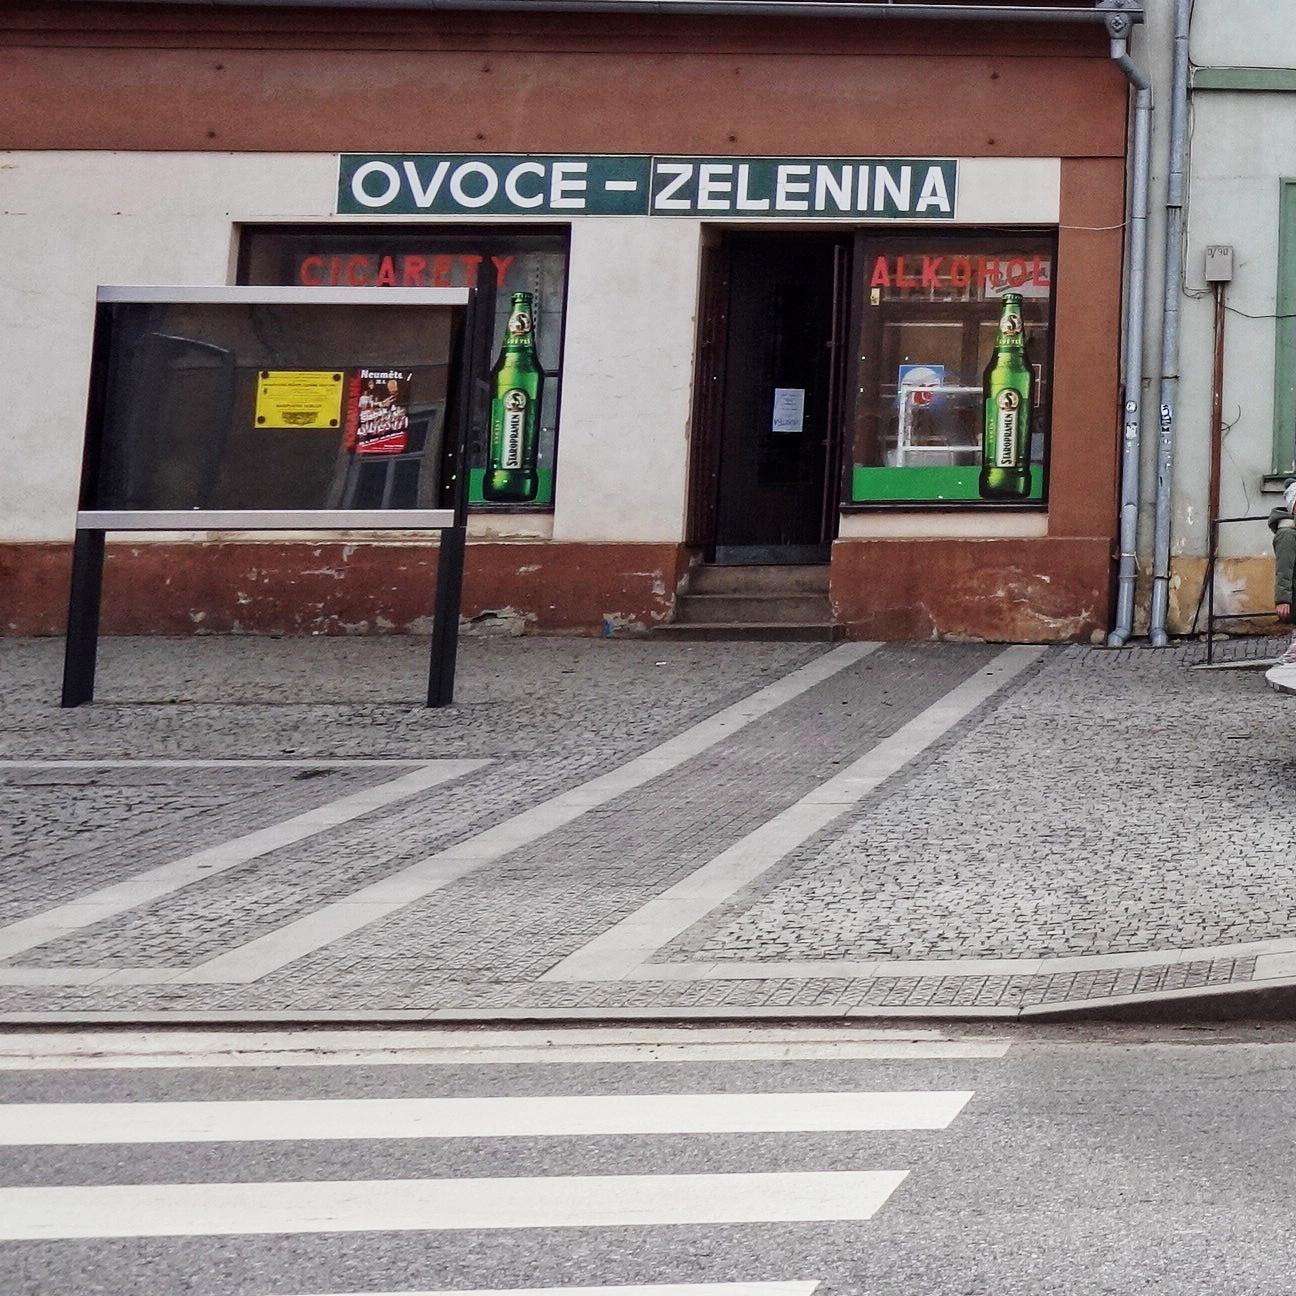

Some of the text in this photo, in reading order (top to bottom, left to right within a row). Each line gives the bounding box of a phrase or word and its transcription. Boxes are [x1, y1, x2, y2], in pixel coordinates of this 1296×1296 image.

[351, 161, 588, 209] OVOCE
[655, 163, 952, 213] ZELENINA
[871, 256, 1050, 288] ALKOHOL
[506, 413, 520, 467] STAROPRAMEN
[1001, 413, 1013, 465] STAROPRAMEN
